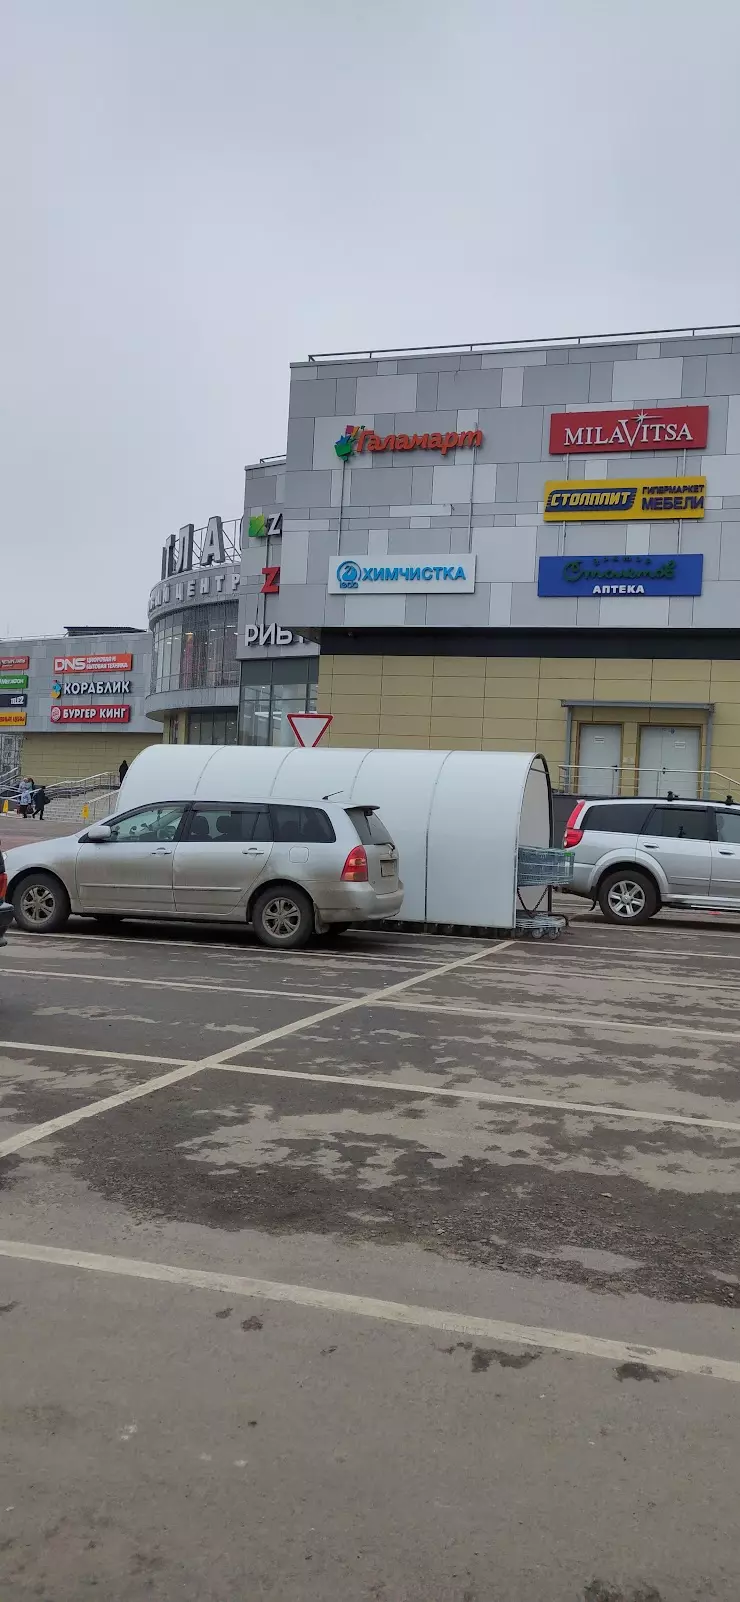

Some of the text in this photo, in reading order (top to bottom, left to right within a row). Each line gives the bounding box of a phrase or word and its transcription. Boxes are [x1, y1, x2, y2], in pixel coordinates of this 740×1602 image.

[563, 418, 694, 447] MILAVITSA
[355, 428, 484, 456] Галамарт
[642, 485, 705, 495] ГИПЕРМАРКЕТ
[641, 496, 704, 511] МЕБЕЛИ
[362, 566, 466, 581] ХИМЧИСТКА
[175, 573, 241, 602] ЦЕНТР
[592, 584, 645, 594] АПТЕКА
[54, 657, 86, 671] DNS
[64, 680, 131, 695] КОРАБЛИК
[62, 707, 127, 719] БУРГЕР КИНГ
